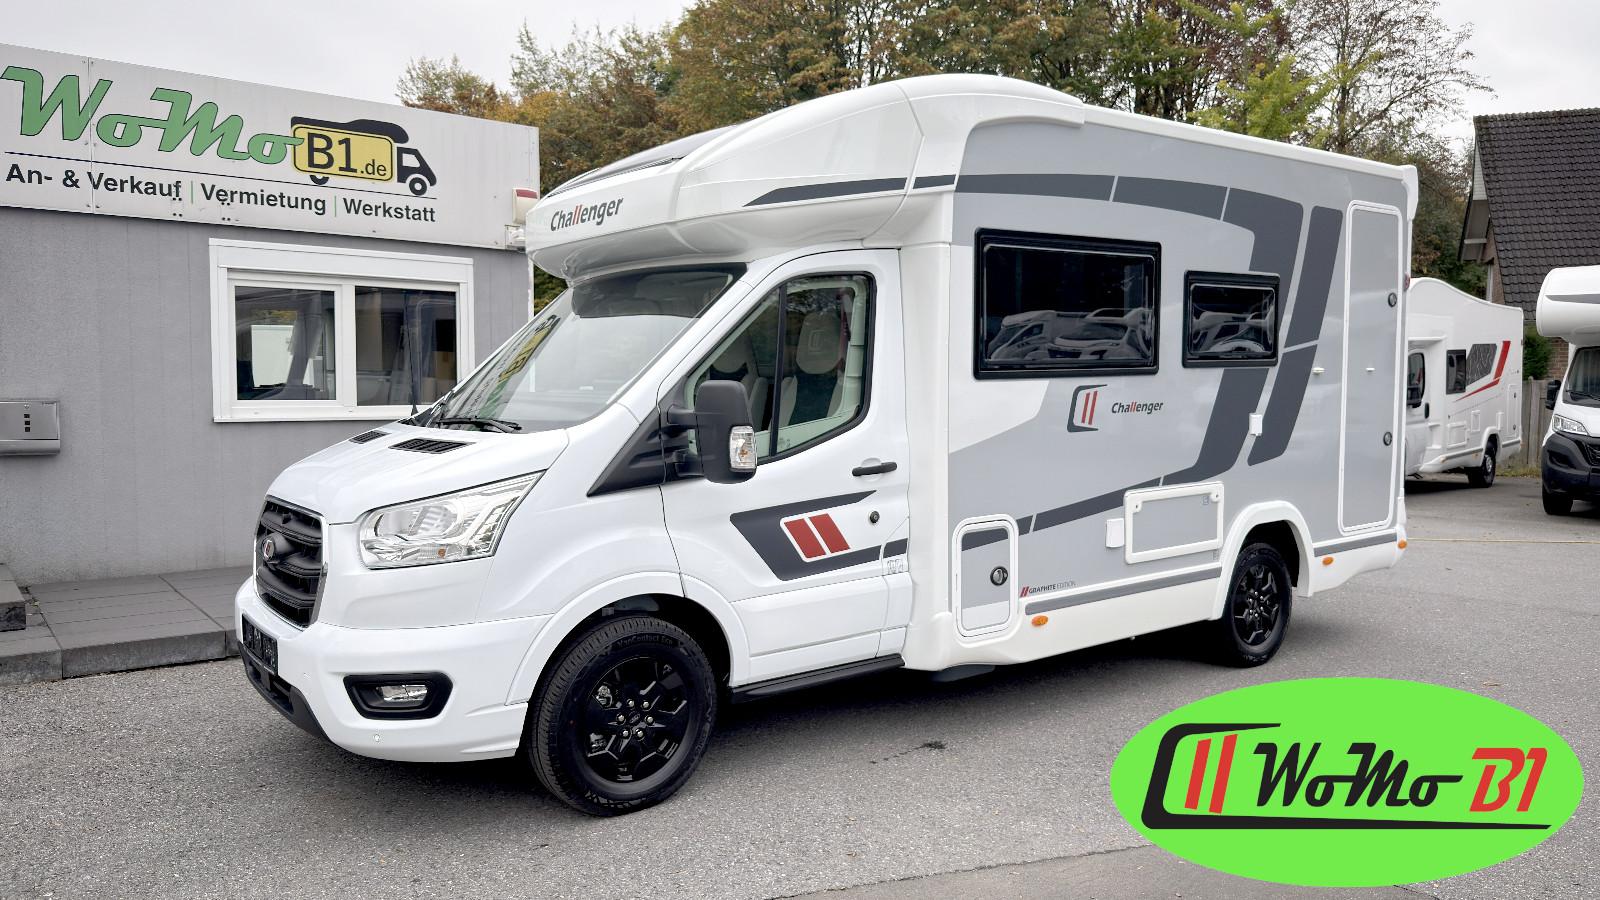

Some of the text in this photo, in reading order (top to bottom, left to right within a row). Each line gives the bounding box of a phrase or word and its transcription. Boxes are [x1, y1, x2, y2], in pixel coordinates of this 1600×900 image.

[0, 65, 304, 164] WoMo
[6, 163, 436, 222] An- & Verkauf Vermietung Werkstatt
[550, 198, 624, 231] Challenger
[1111, 401, 1163, 415] Challenger
[1028, 584, 1056, 594] GRAPHITE
